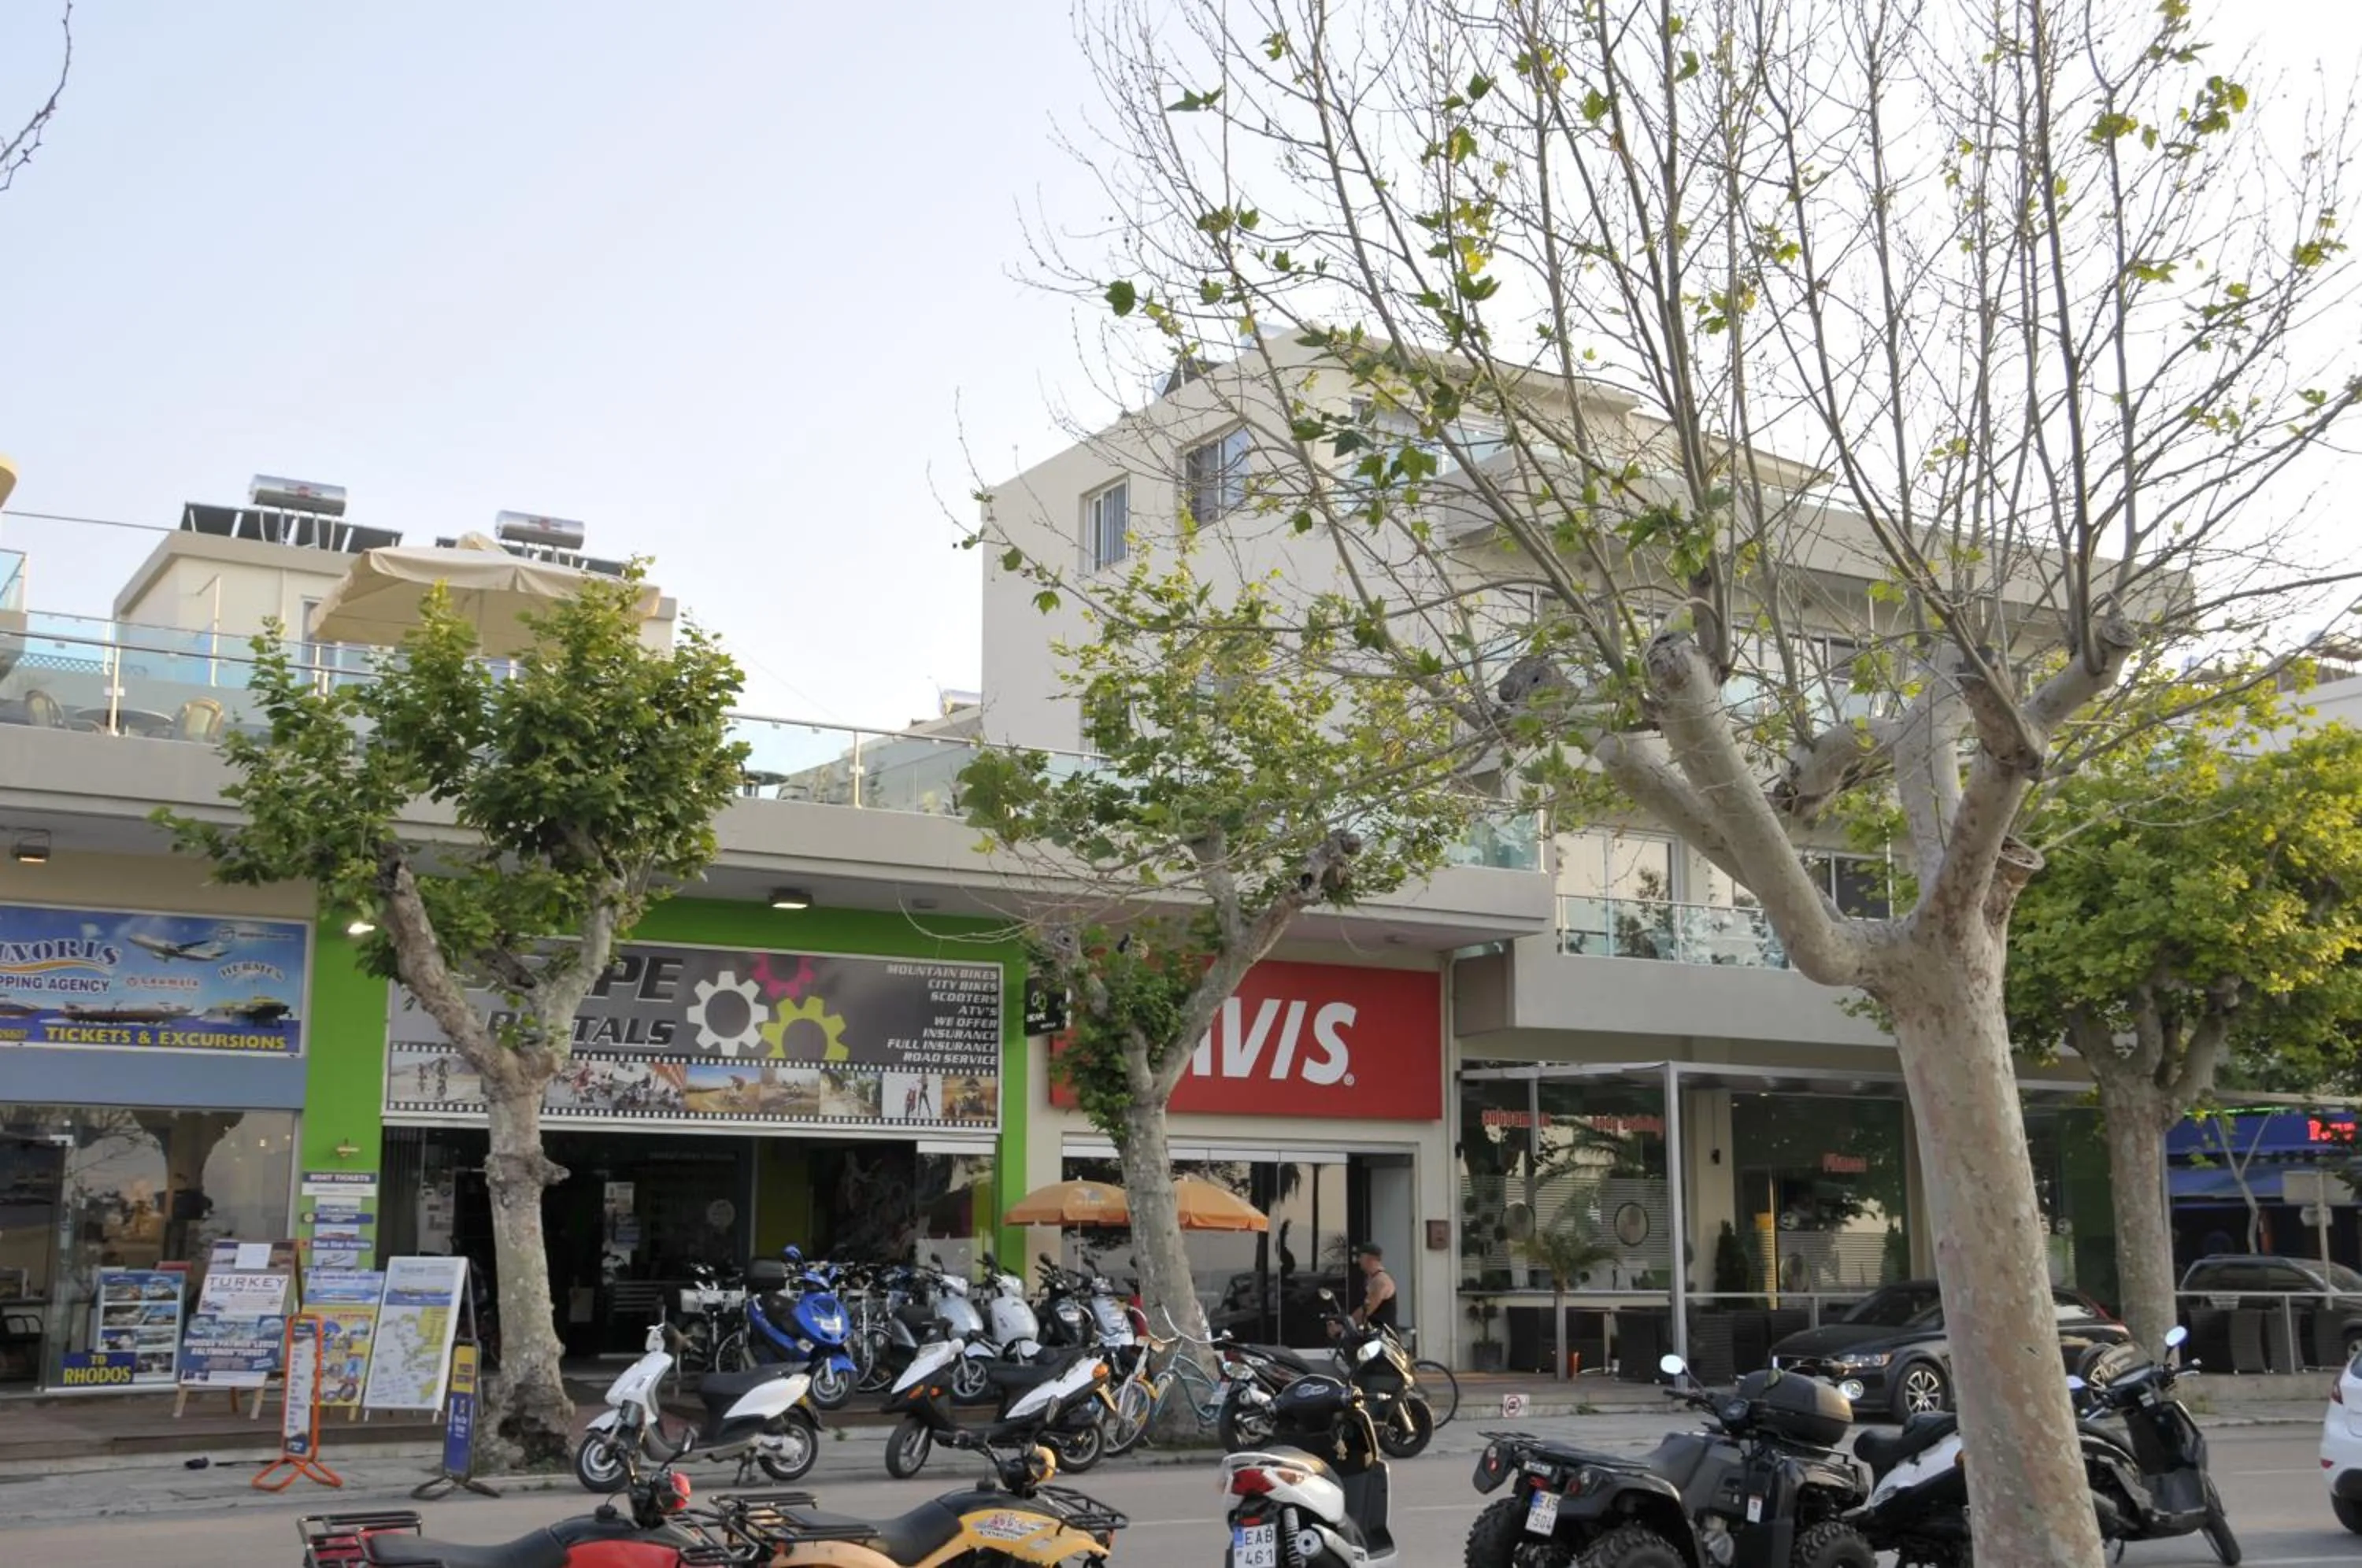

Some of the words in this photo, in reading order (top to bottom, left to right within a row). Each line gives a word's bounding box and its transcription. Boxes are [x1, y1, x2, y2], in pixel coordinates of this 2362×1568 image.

[886, 964, 957, 978] MOUNTAIN
[959, 969, 998, 980] BIKES
[48, 978, 110, 992] AGENCY
[927, 979, 957, 989] CITY
[958, 982, 998, 992] BIKES
[931, 991, 998, 1004] SCOOTERS
[957, 1005, 998, 1016] ATV'S
[935, 1016, 954, 1026] WE
[956, 1018, 998, 1029] OFFER
[46, 1026, 131, 1043] TICKETS
[138, 1030, 151, 1045] &
[159, 1031, 286, 1050] EXCURSIONS
[923, 1028, 997, 1041] INSURANCE
[887, 1038, 920, 1049] FULL
[923, 1040, 997, 1053] INSURANCE
[903, 1052, 941, 1063] ROAD
[943, 1053, 997, 1065] SERVICE
[209, 1277, 285, 1287] TURKEY
[63, 1366, 131, 1385] RHODOS
[1245, 1549, 1273, 1565] 461
